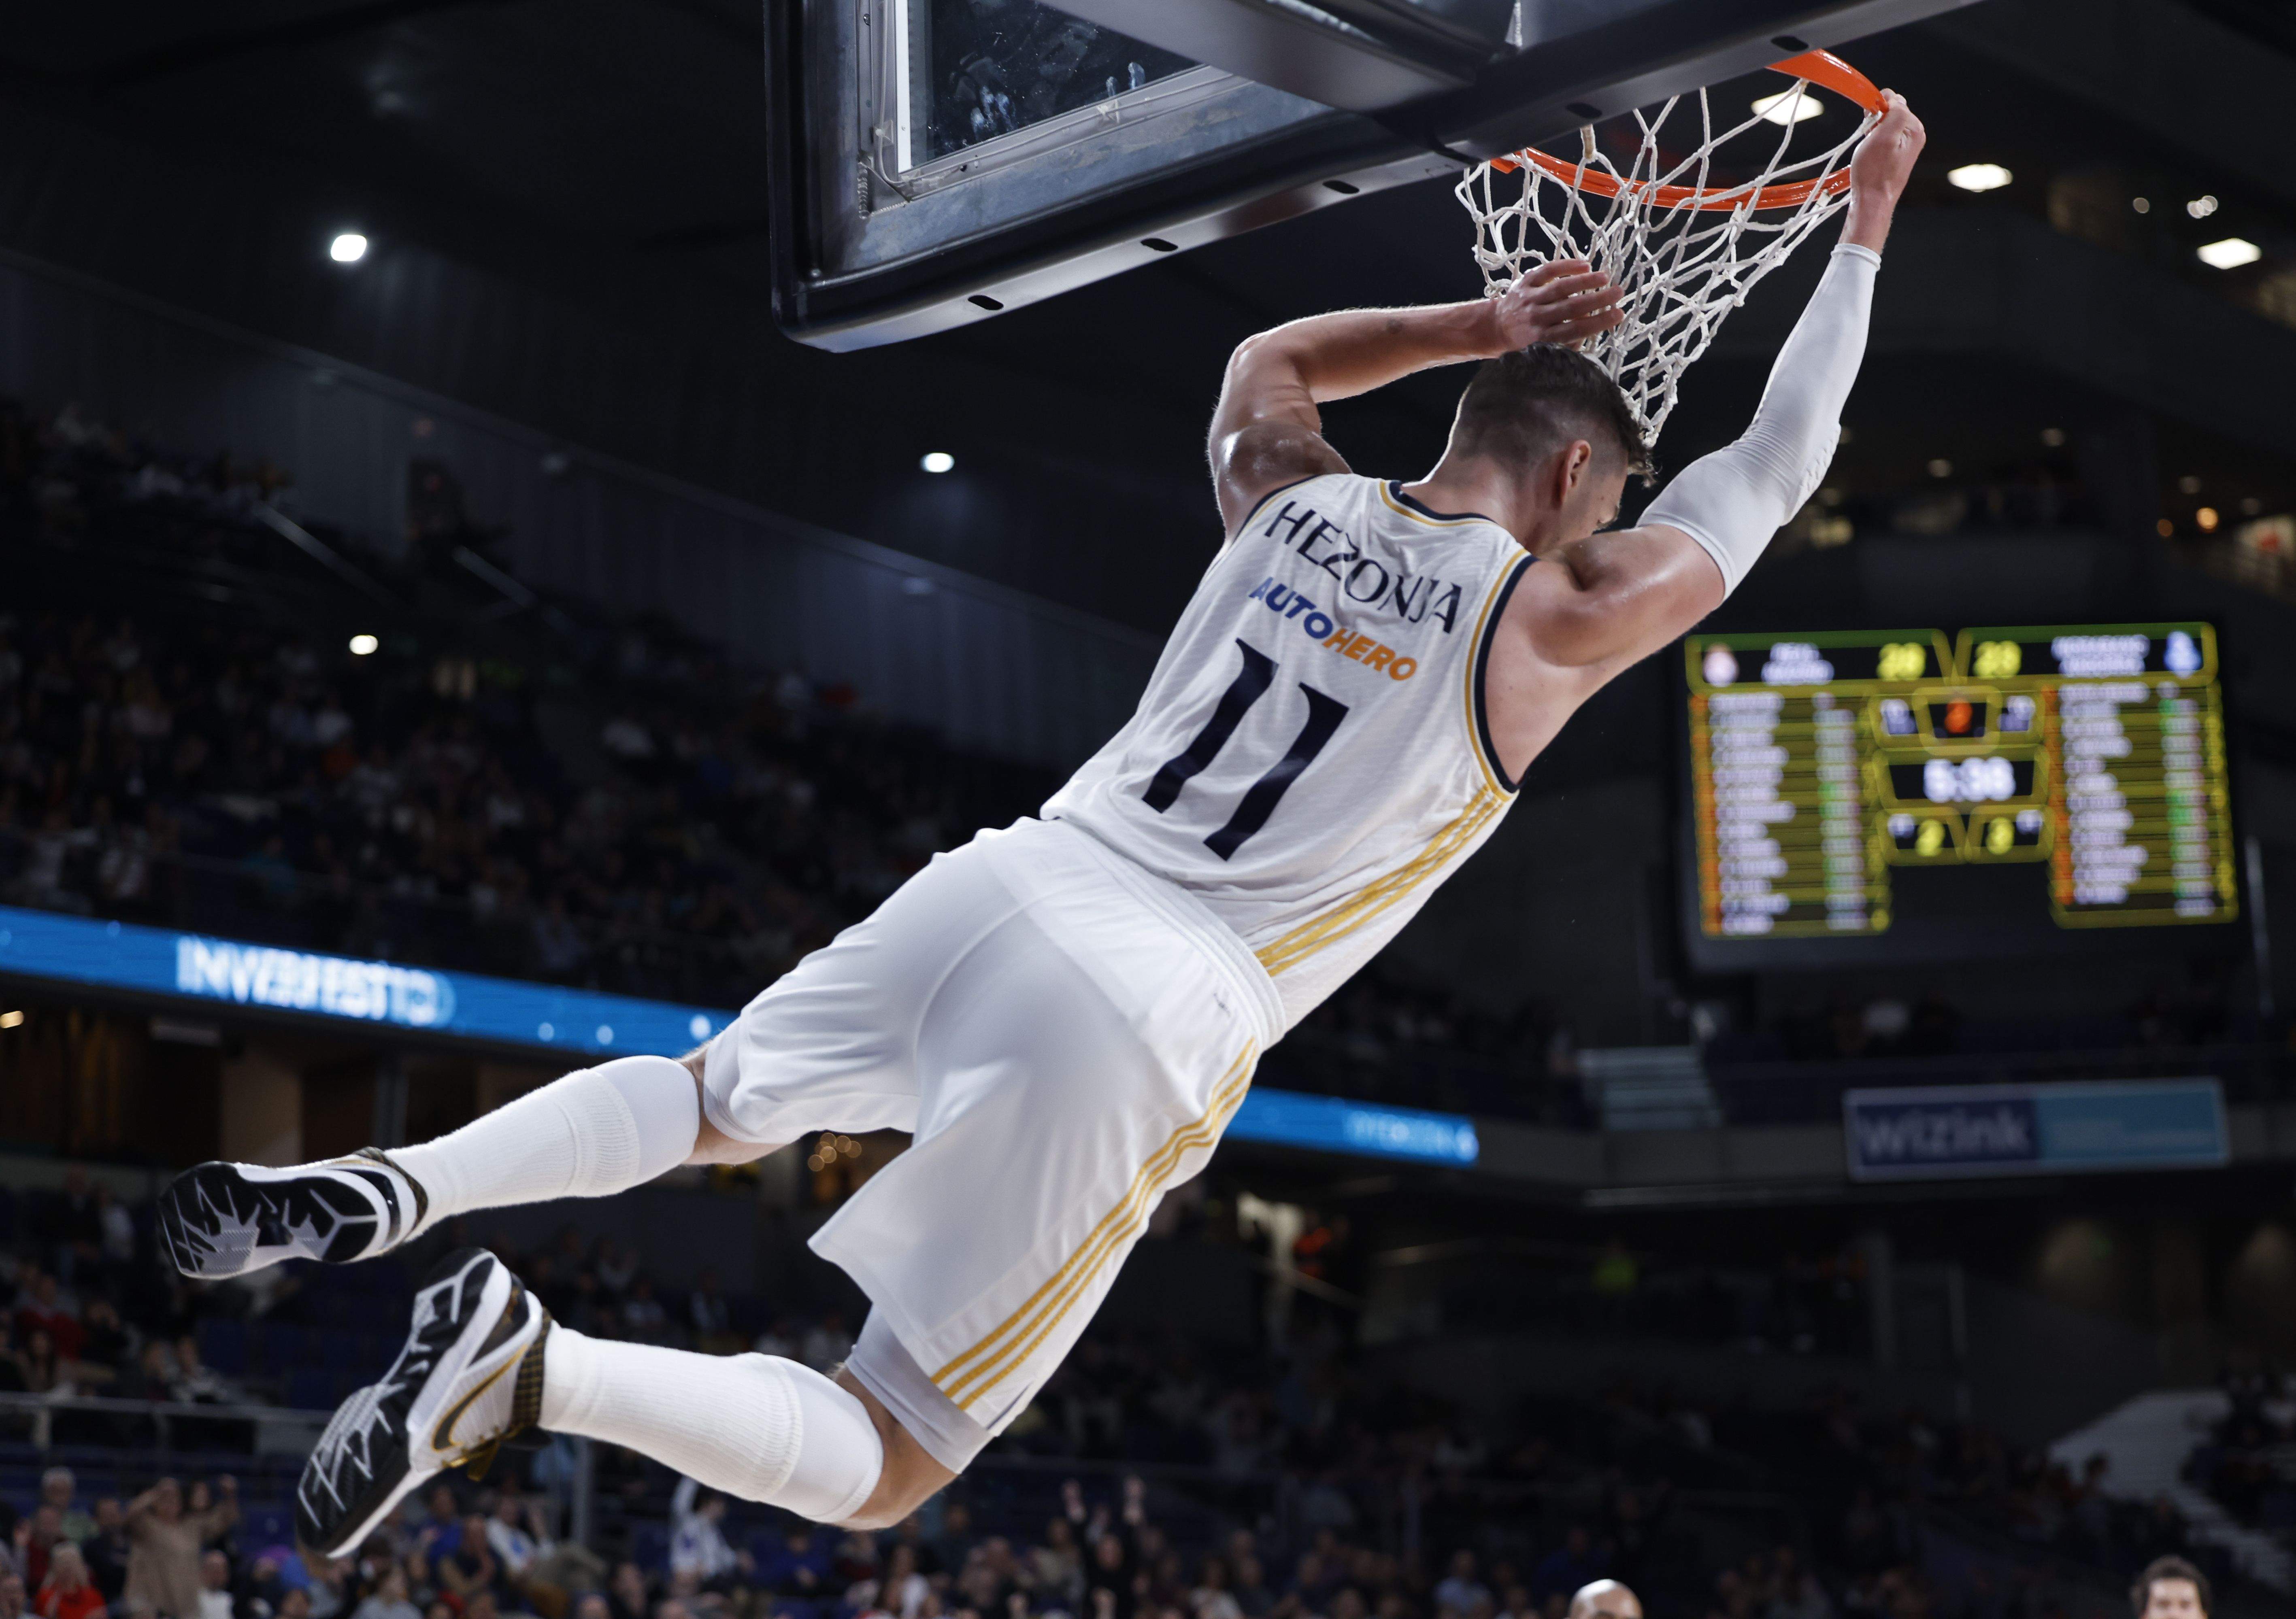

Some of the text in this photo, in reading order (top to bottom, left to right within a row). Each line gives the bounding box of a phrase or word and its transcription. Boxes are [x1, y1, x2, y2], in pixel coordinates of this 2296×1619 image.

[1249, 577, 1417, 681] AUTOHERO
[1264, 500, 1462, 633] HEZONJA
[1142, 637, 1349, 862] 11
